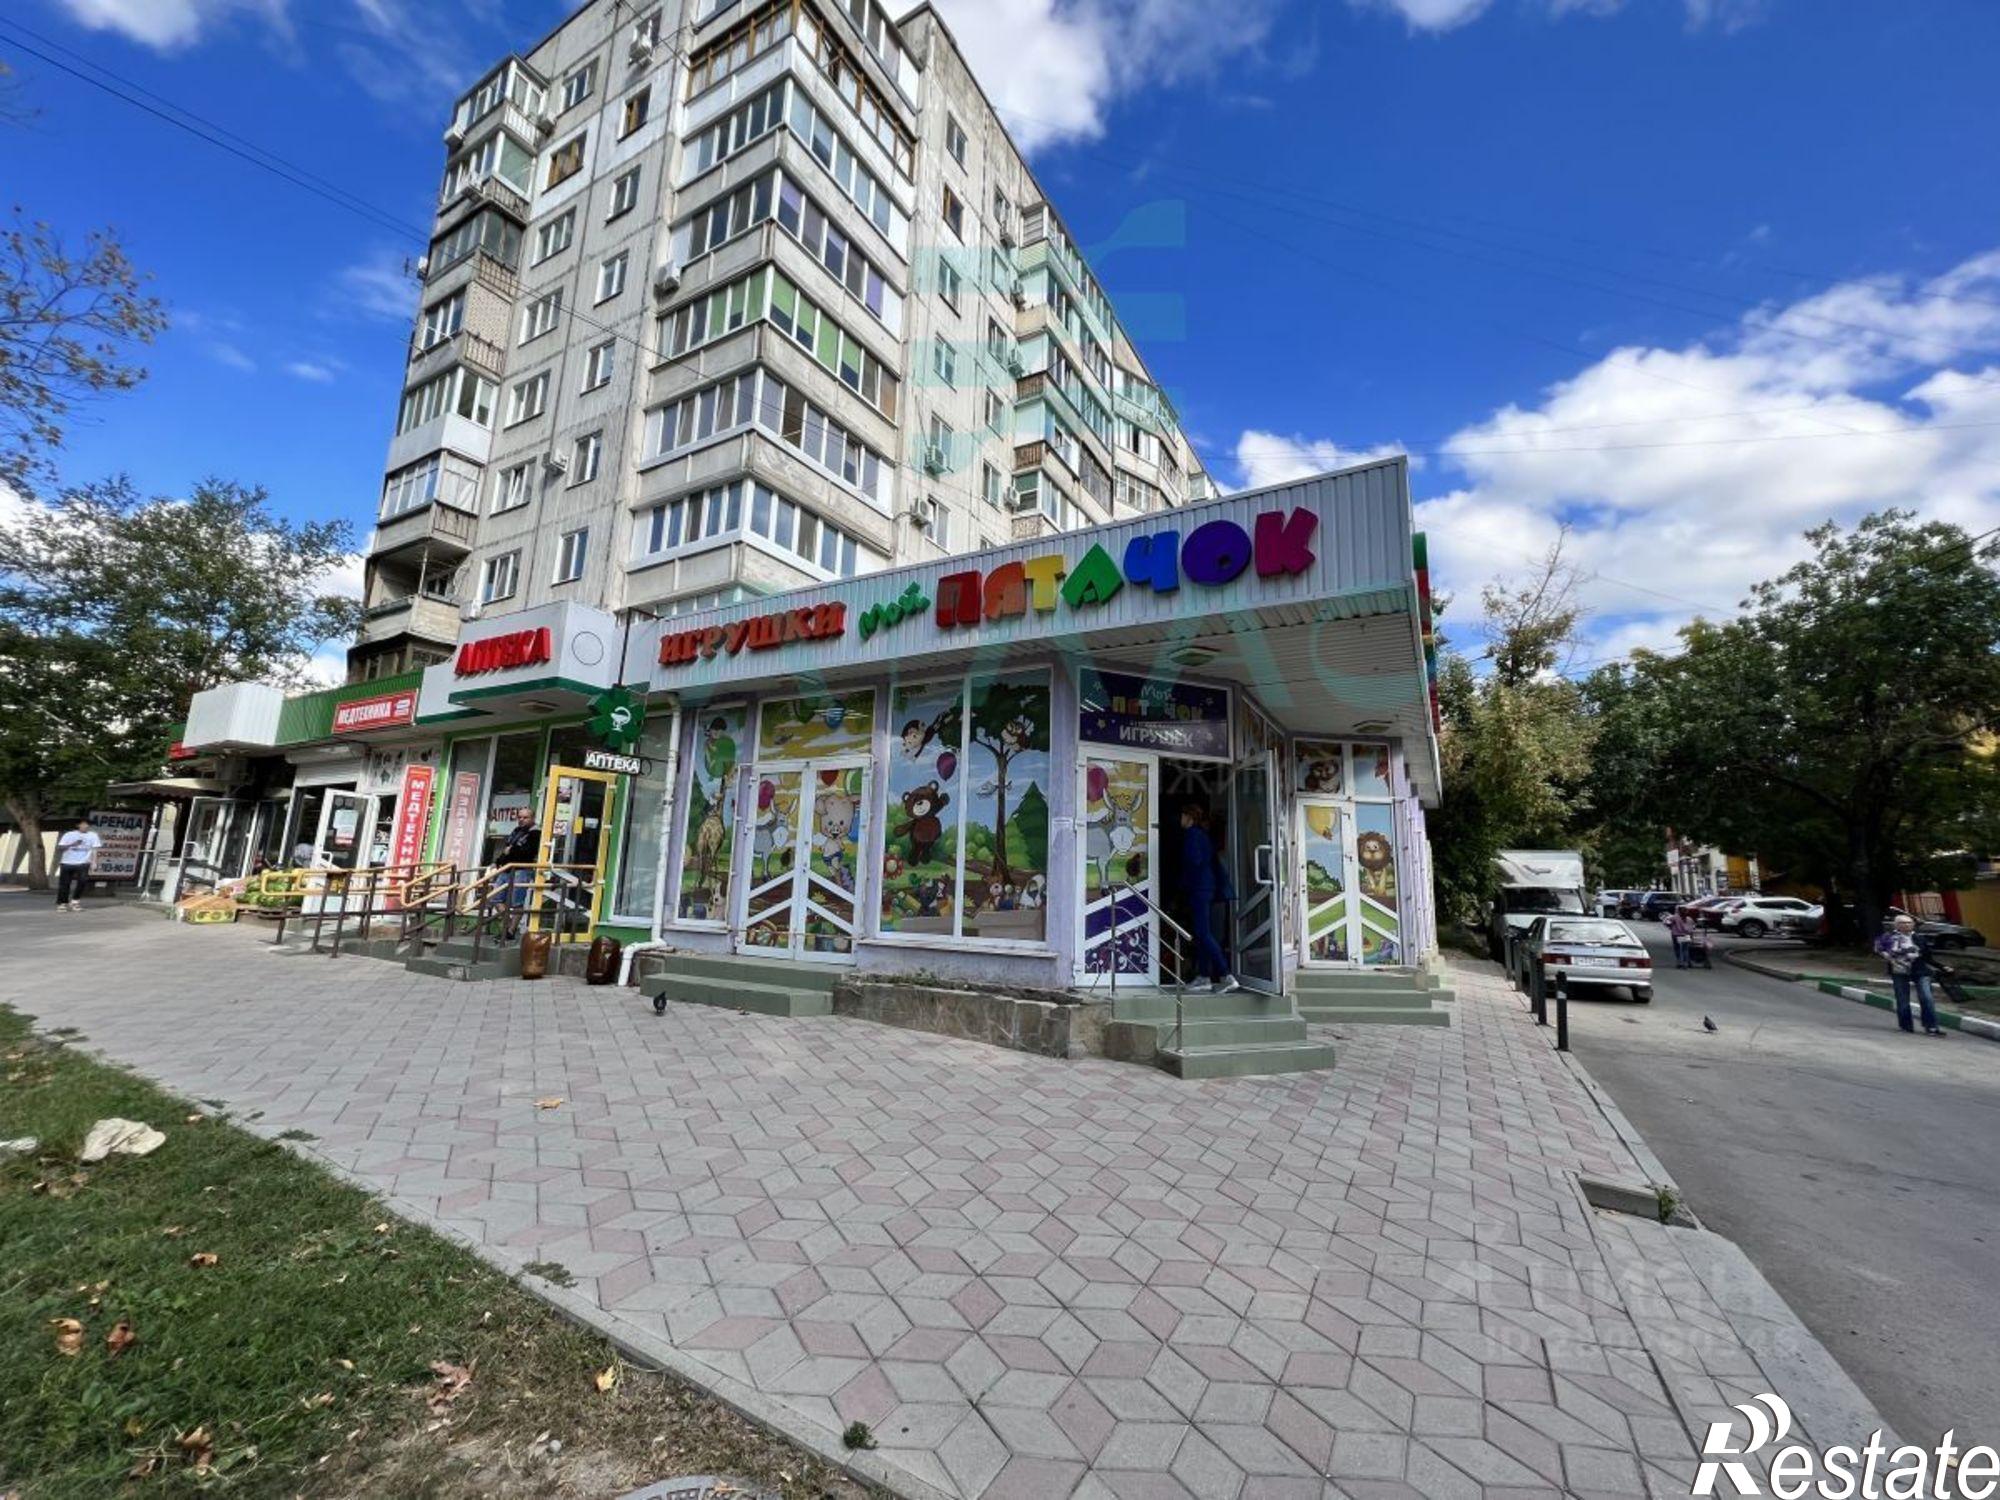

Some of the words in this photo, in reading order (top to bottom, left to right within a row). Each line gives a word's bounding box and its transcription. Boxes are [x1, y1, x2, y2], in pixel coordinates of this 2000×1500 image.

[658, 601, 846, 666] ИГРУШКИ
[936, 506, 1318, 628] ПЯТАЧОК
[455, 626, 550, 676] АПТЕКА
[585, 752, 640, 774] АПТЕКА
